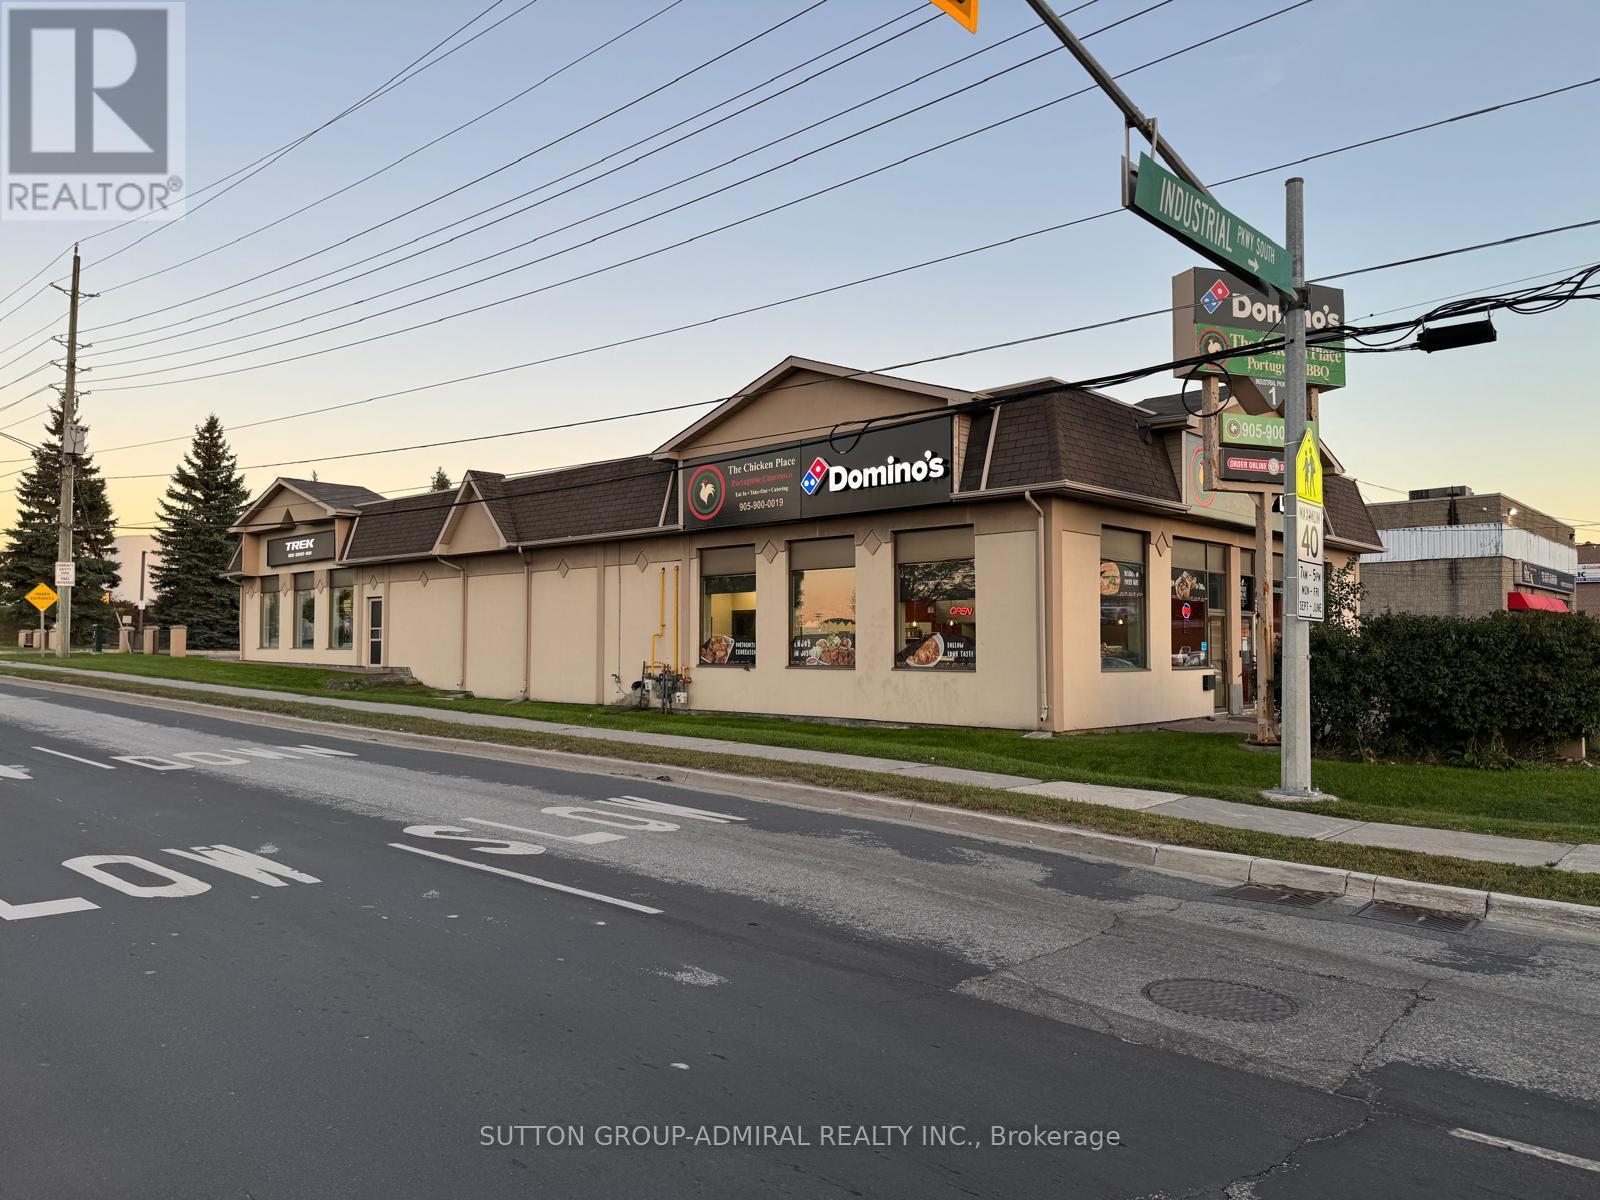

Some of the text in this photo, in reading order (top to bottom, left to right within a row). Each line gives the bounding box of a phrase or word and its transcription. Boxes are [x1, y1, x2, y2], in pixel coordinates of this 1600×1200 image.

[1159, 177, 1275, 265] INDUSTRIAL PKWY SOUTH
[1232, 293, 1340, 330] Domo's
[1247, 357, 1329, 381] Portug BBQ
[1268, 386, 1276, 405] 1
[1242, 422, 1285, 440] 905-900
[728, 458, 796, 475] The Chicken Place
[829, 450, 945, 492] Domino's
[1229, 460, 1268, 470] ORDER ONLINE
[739, 498, 784, 511] 905-900-0019
[285, 538, 315, 551] TREK
[1301, 524, 1319, 559] 40
[949, 606, 973, 616] OPEN
[0, 844, 323, 921] LOW
